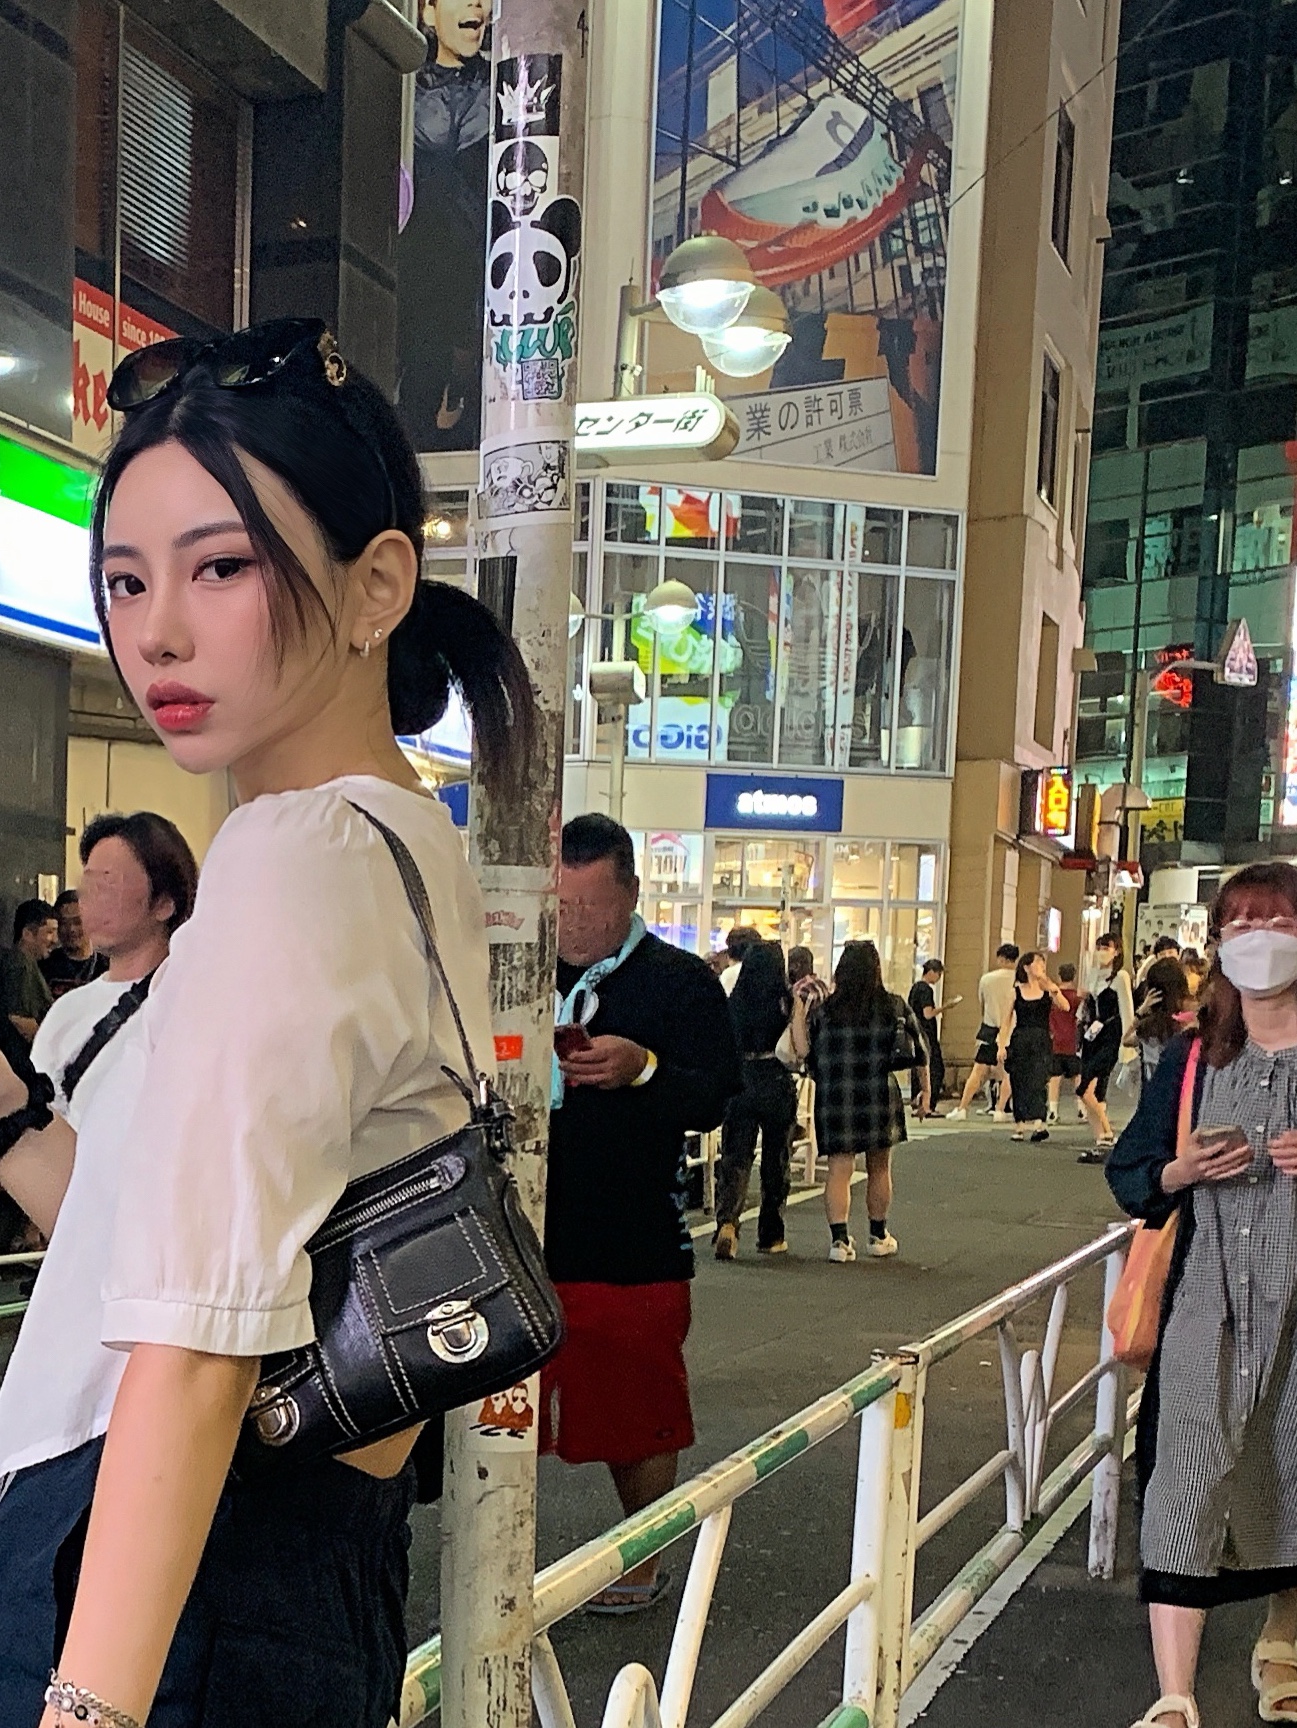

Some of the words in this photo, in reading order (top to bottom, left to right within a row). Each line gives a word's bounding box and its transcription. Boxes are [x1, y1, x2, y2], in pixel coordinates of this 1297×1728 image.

[79, 291, 110, 328] House
[122, 316, 147, 348] since
[576, 408, 709, 437] センター街
[746, 387, 864, 442] 業の許可票
[736, 789, 818, 817] atmos
